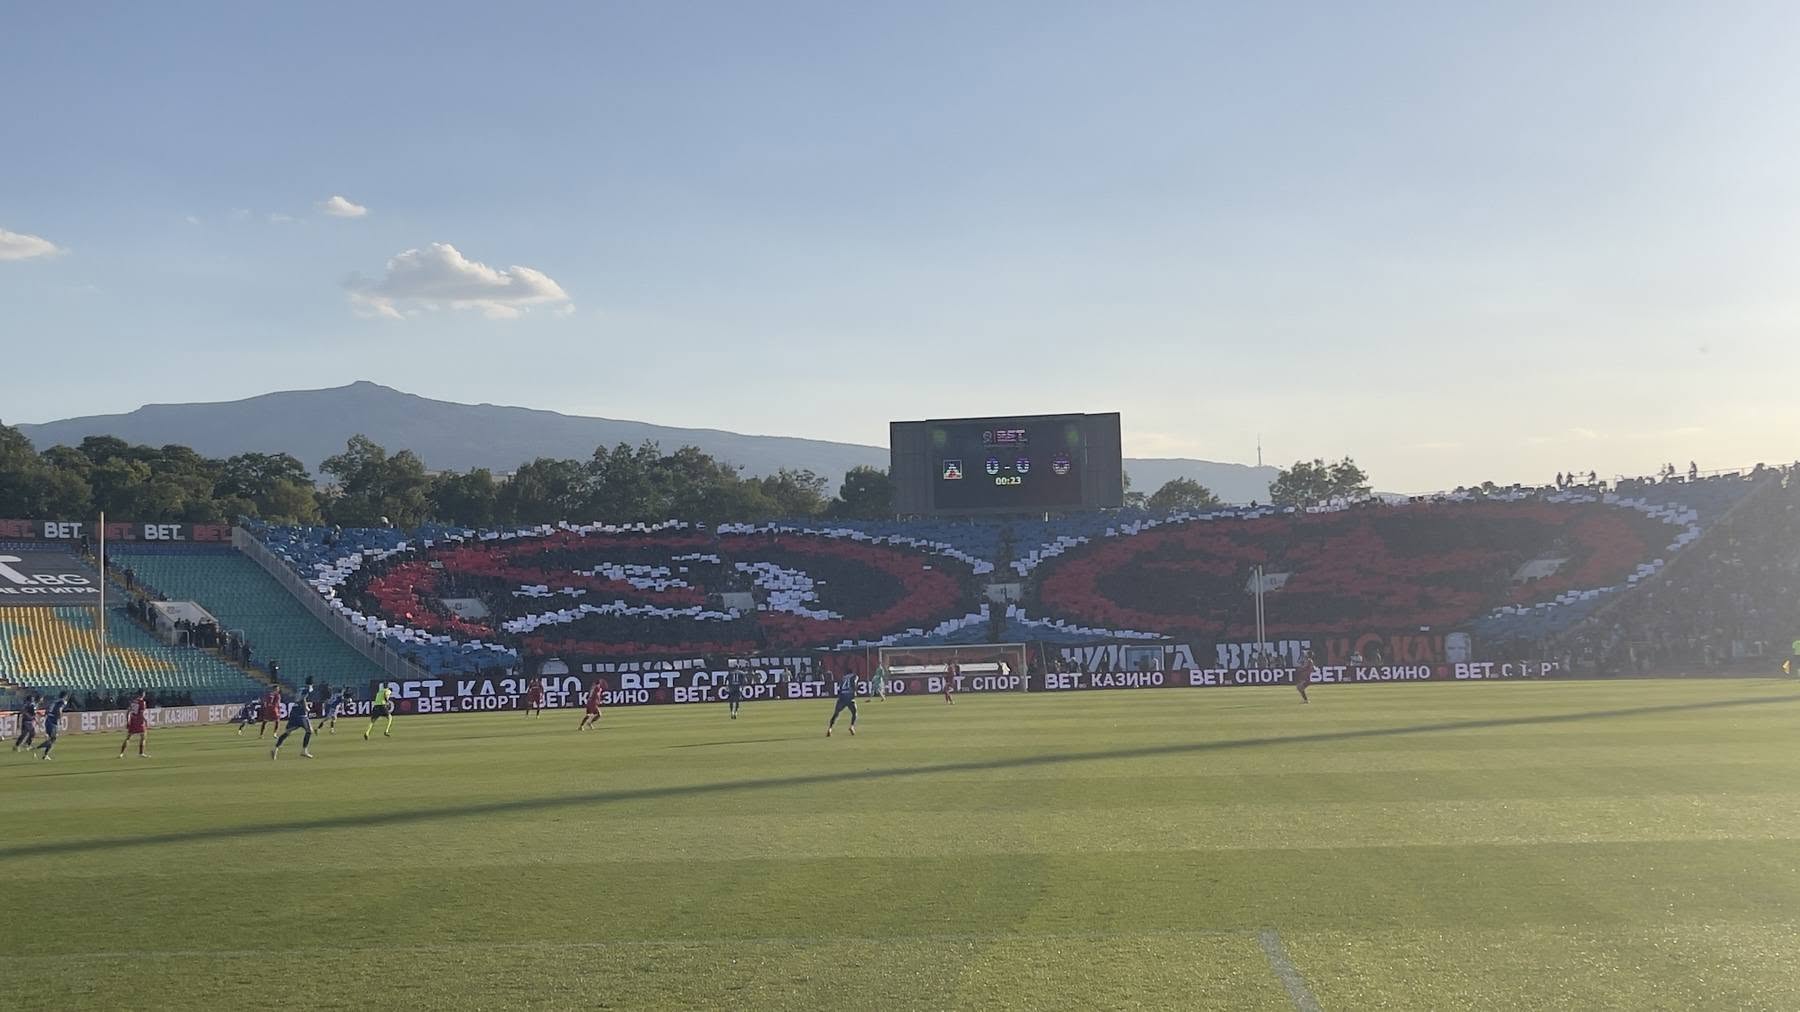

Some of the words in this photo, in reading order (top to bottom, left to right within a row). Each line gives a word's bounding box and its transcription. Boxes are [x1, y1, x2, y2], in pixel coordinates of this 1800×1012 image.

[995, 477, 1021, 486] 00:23
[1091, 671, 1164, 687] КАЗИНО
[1235, 668, 1296, 683] СПОРТ
[1356, 665, 1431, 681] КАЗИНО
[719, 684, 776, 700] СОРТ
[462, 694, 520, 710] СПОРТ
